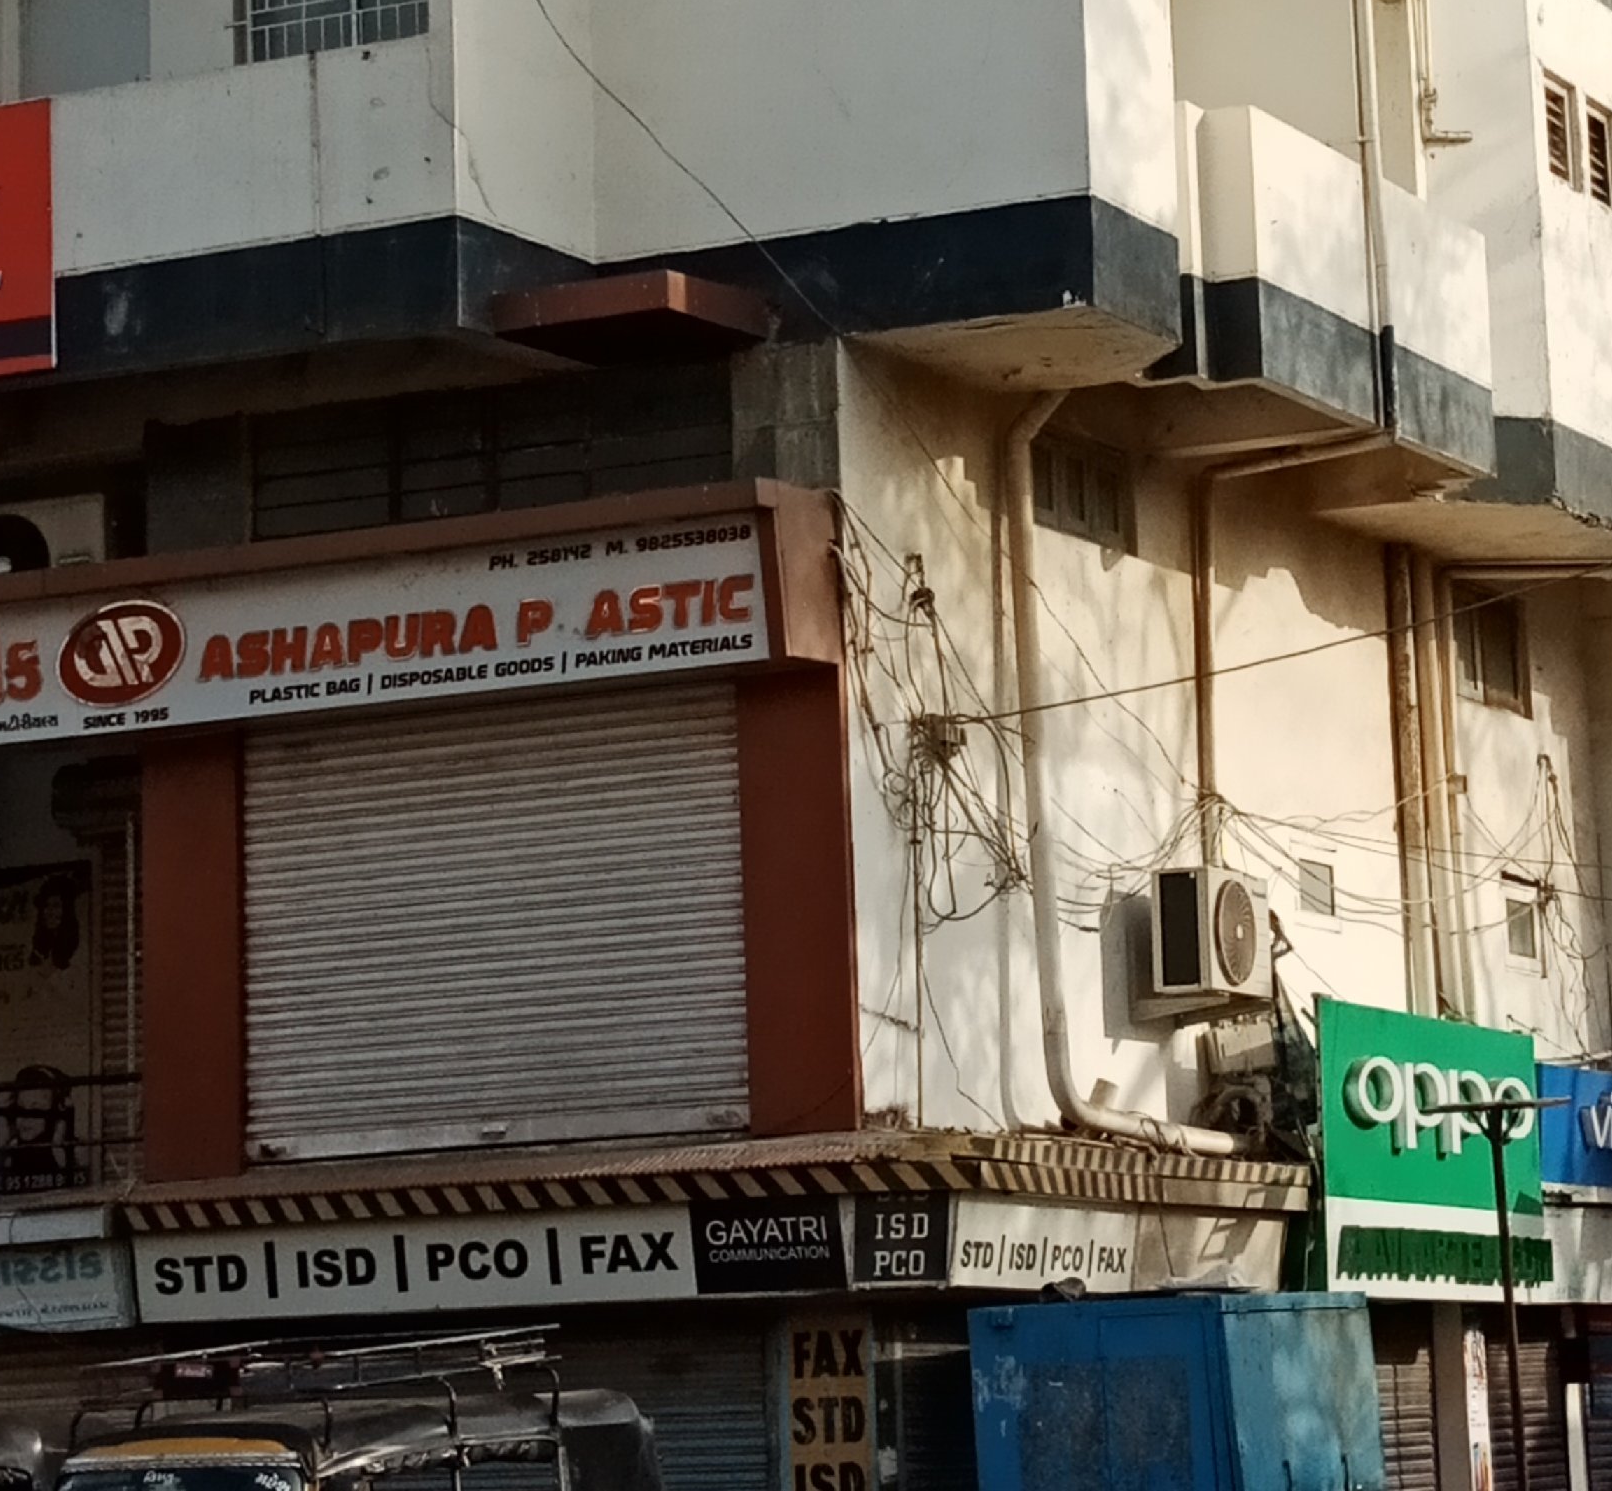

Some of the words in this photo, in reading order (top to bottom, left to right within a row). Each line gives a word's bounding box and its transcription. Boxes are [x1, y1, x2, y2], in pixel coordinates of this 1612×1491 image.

[488, 554, 518, 572] PH.
[526, 543, 592, 566] 258142
[604, 539, 628, 558] M.
[635, 524, 752, 553] 9825538038
[198, 605, 498, 682] ASHAPURA
[247, 680, 321, 705] PLASTIC
[324, 675, 362, 696] BAG
[380, 663, 489, 690] DISPOSABLE
[494, 656, 555, 678] GOODS
[574, 646, 643, 670] PAKING
[647, 634, 753, 661] MATERIALS
[83, 714, 127, 729] SINCE
[133, 707, 170, 724] 1995
[1351, 1055, 1536, 1157] oppo
[704, 1215, 829, 1248] GAYATRI
[874, 1212, 929, 1242] ISD
[154, 1252, 249, 1297] STD
[296, 1244, 377, 1289] ISD
[425, 1237, 529, 1284] PCO
[579, 1230, 680, 1276] FAX
[708, 1245, 830, 1265] COMMUNICATION
[873, 1249, 927, 1278] PCO
[959, 1240, 995, 1271] STD
[1008, 1243, 1037, 1271] ISD
[1050, 1243, 1085, 1272] PCO
[1097, 1244, 1128, 1273] FAX
[792, 1329, 864, 1379] FAX
[792, 1396, 866, 1445] STD
